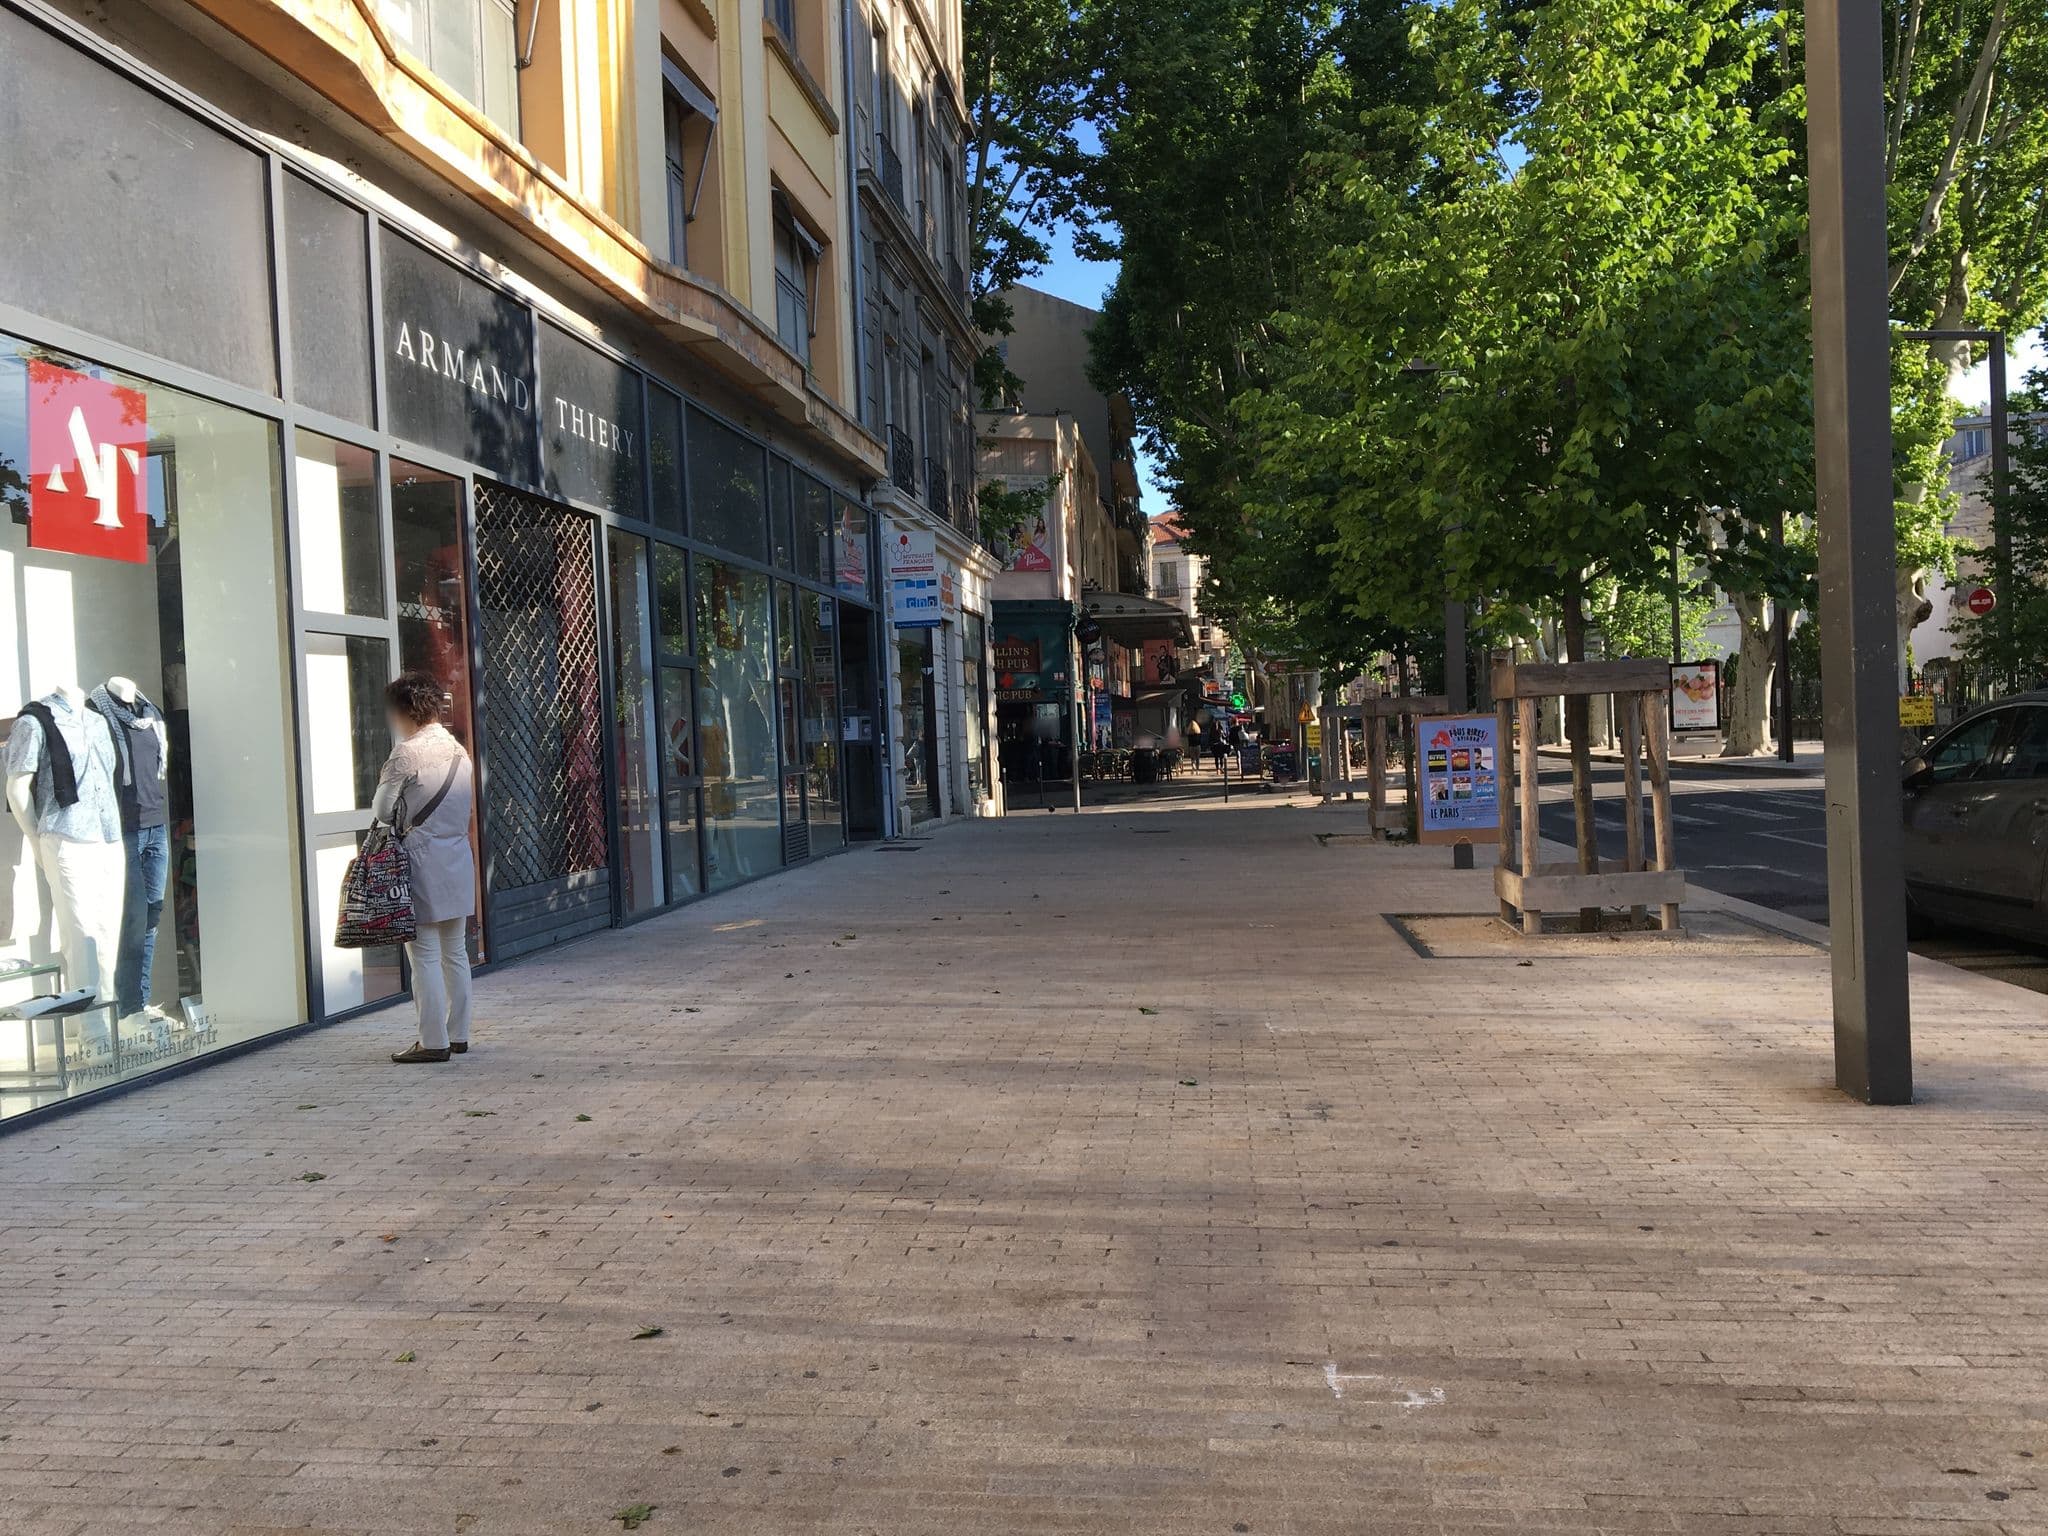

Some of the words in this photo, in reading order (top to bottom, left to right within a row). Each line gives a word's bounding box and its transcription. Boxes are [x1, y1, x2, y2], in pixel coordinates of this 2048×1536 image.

[396, 322, 530, 412] ARMAND
[556, 397, 634, 458] THIERY
[1007, 659, 1029, 669] PUB
[1011, 690, 1032, 700] PUB
[1440, 807, 1460, 819] PARIS
